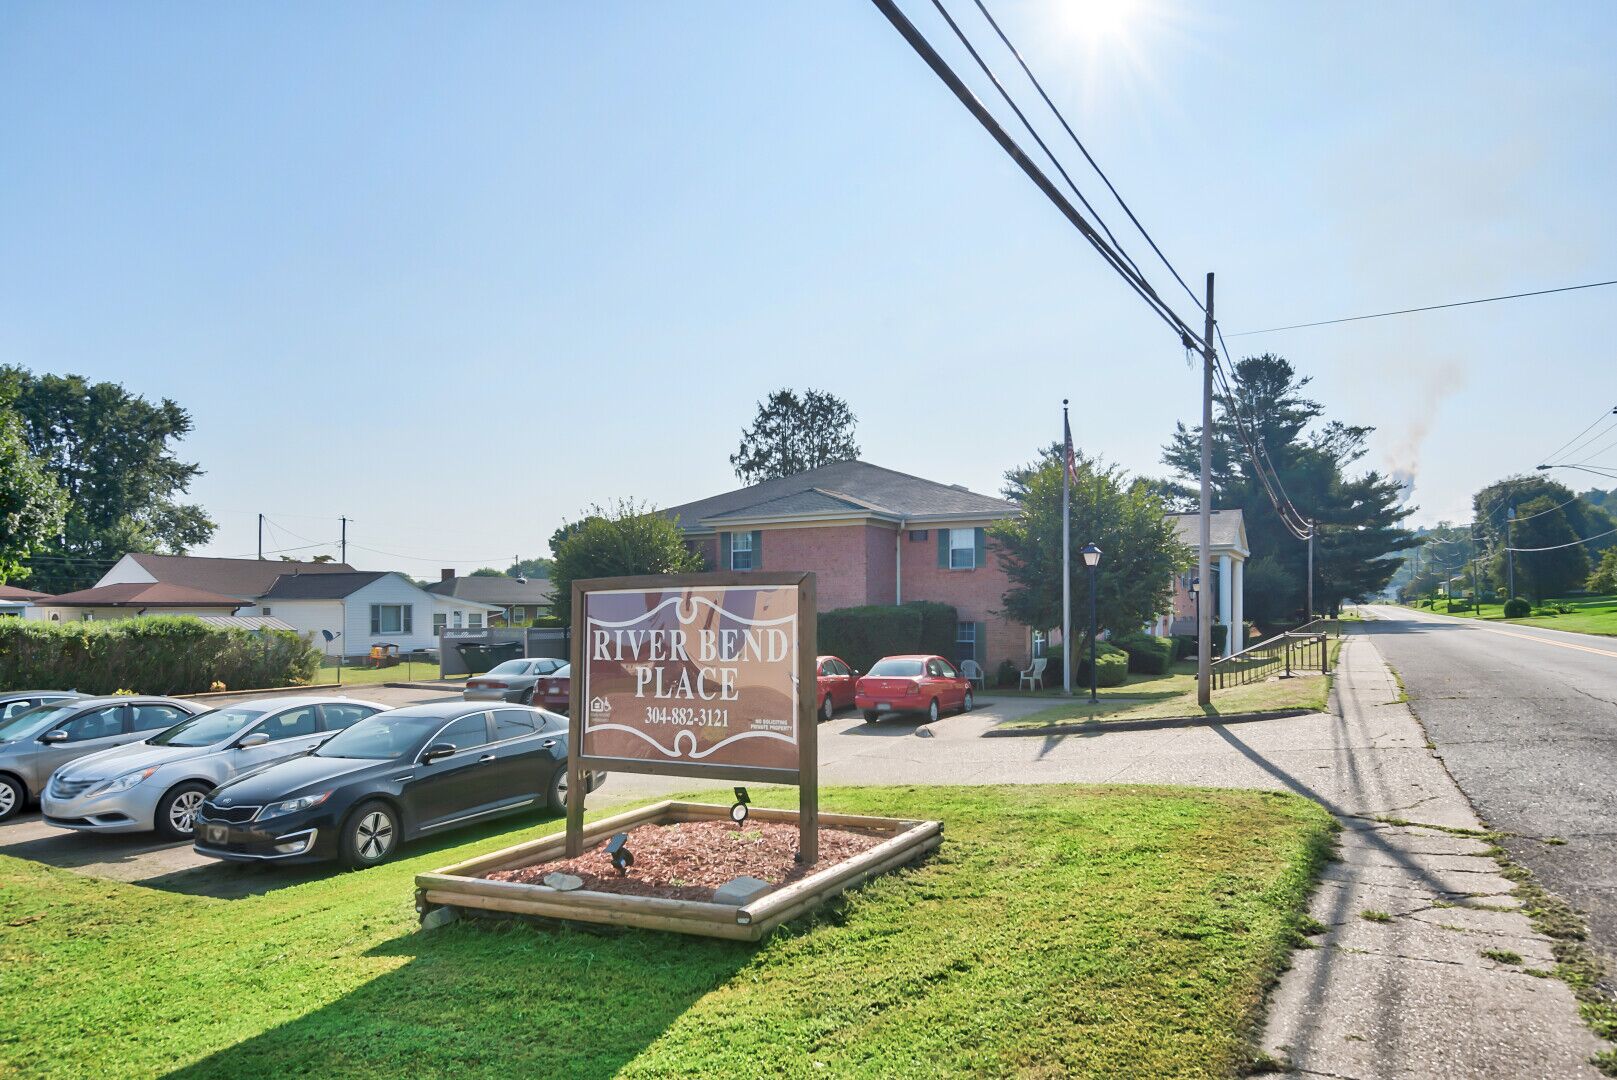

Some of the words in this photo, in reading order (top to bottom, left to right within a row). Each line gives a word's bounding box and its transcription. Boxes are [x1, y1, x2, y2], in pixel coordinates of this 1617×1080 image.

[593, 629, 689, 661] RIVER
[698, 628, 788, 662] BEND
[635, 666, 739, 701] PLACE
[645, 706, 728, 727] 304-882-3121
